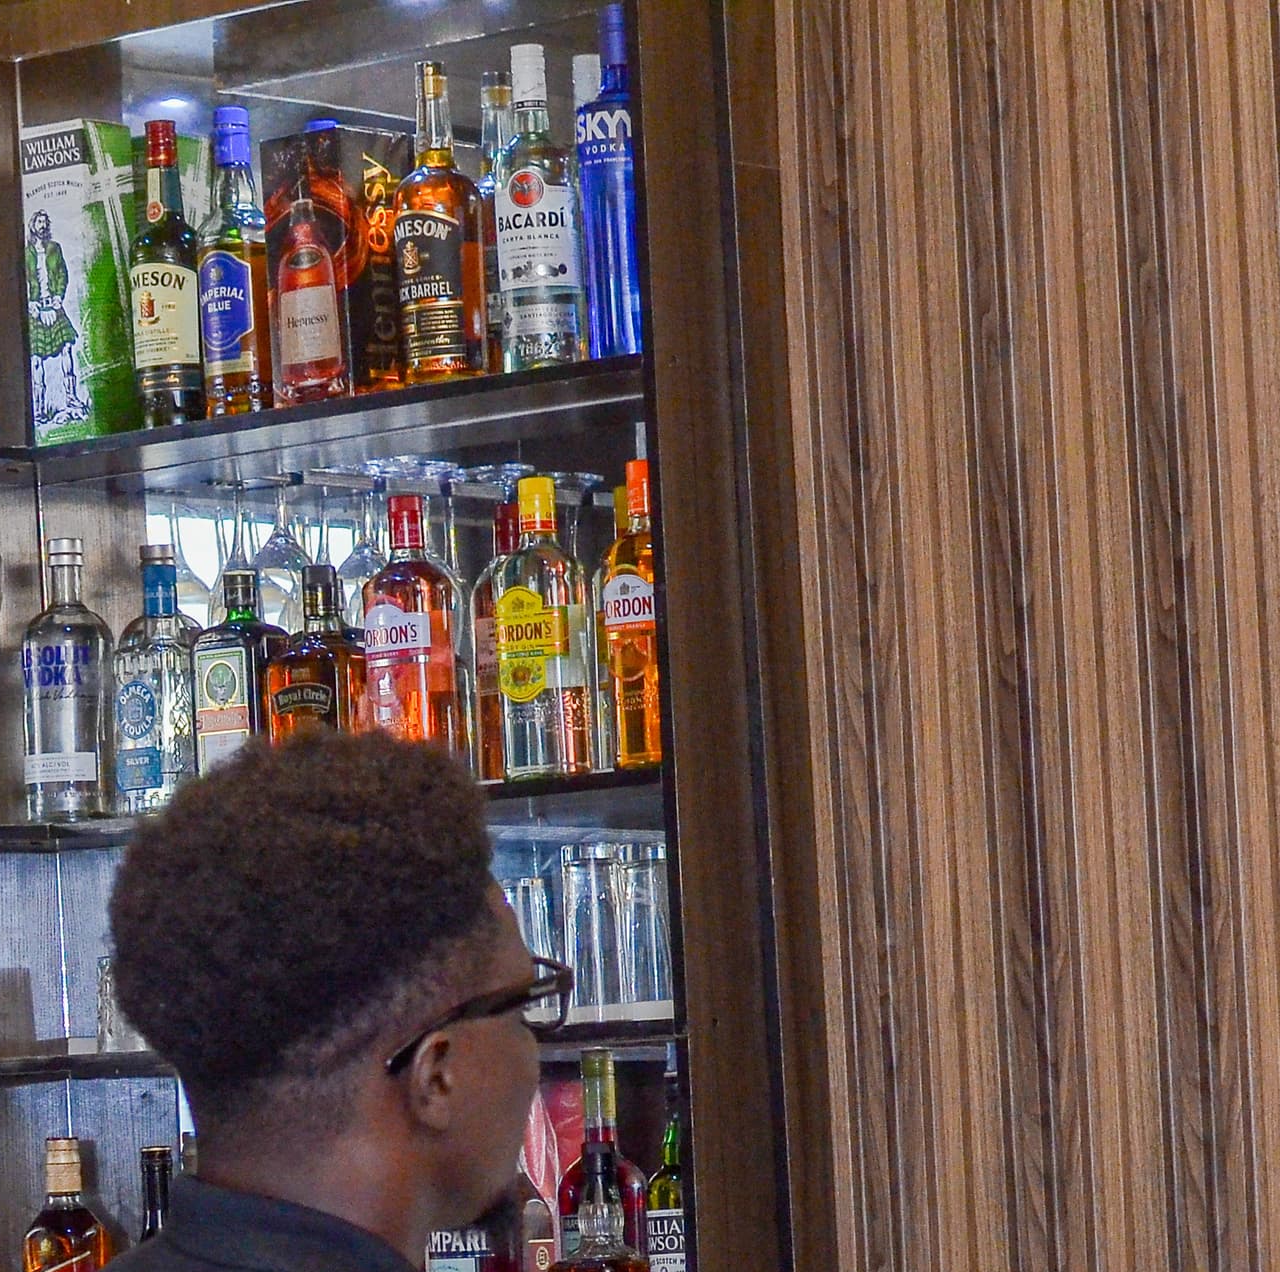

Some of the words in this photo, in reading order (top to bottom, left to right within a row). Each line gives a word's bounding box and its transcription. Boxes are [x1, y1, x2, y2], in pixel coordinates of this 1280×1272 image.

[577, 109, 633, 144] SKYY
[26, 134, 76, 155] WILLIAM
[585, 143, 626, 156] VODKA
[498, 206, 566, 233] BACARDÍ
[412, 281, 454, 300] BARREL
[207, 300, 232, 314] BLUE
[287, 314, 330, 331] Hennessy
[365, 621, 418, 648] ORDON'S
[21, 644, 90, 668] BSOLUT
[120, 685, 152, 705] OLMECA
[121, 715, 153, 735] TEQUILA
[126, 756, 150, 767] SILVER
[648, 1218, 685, 1237] ILLIA
